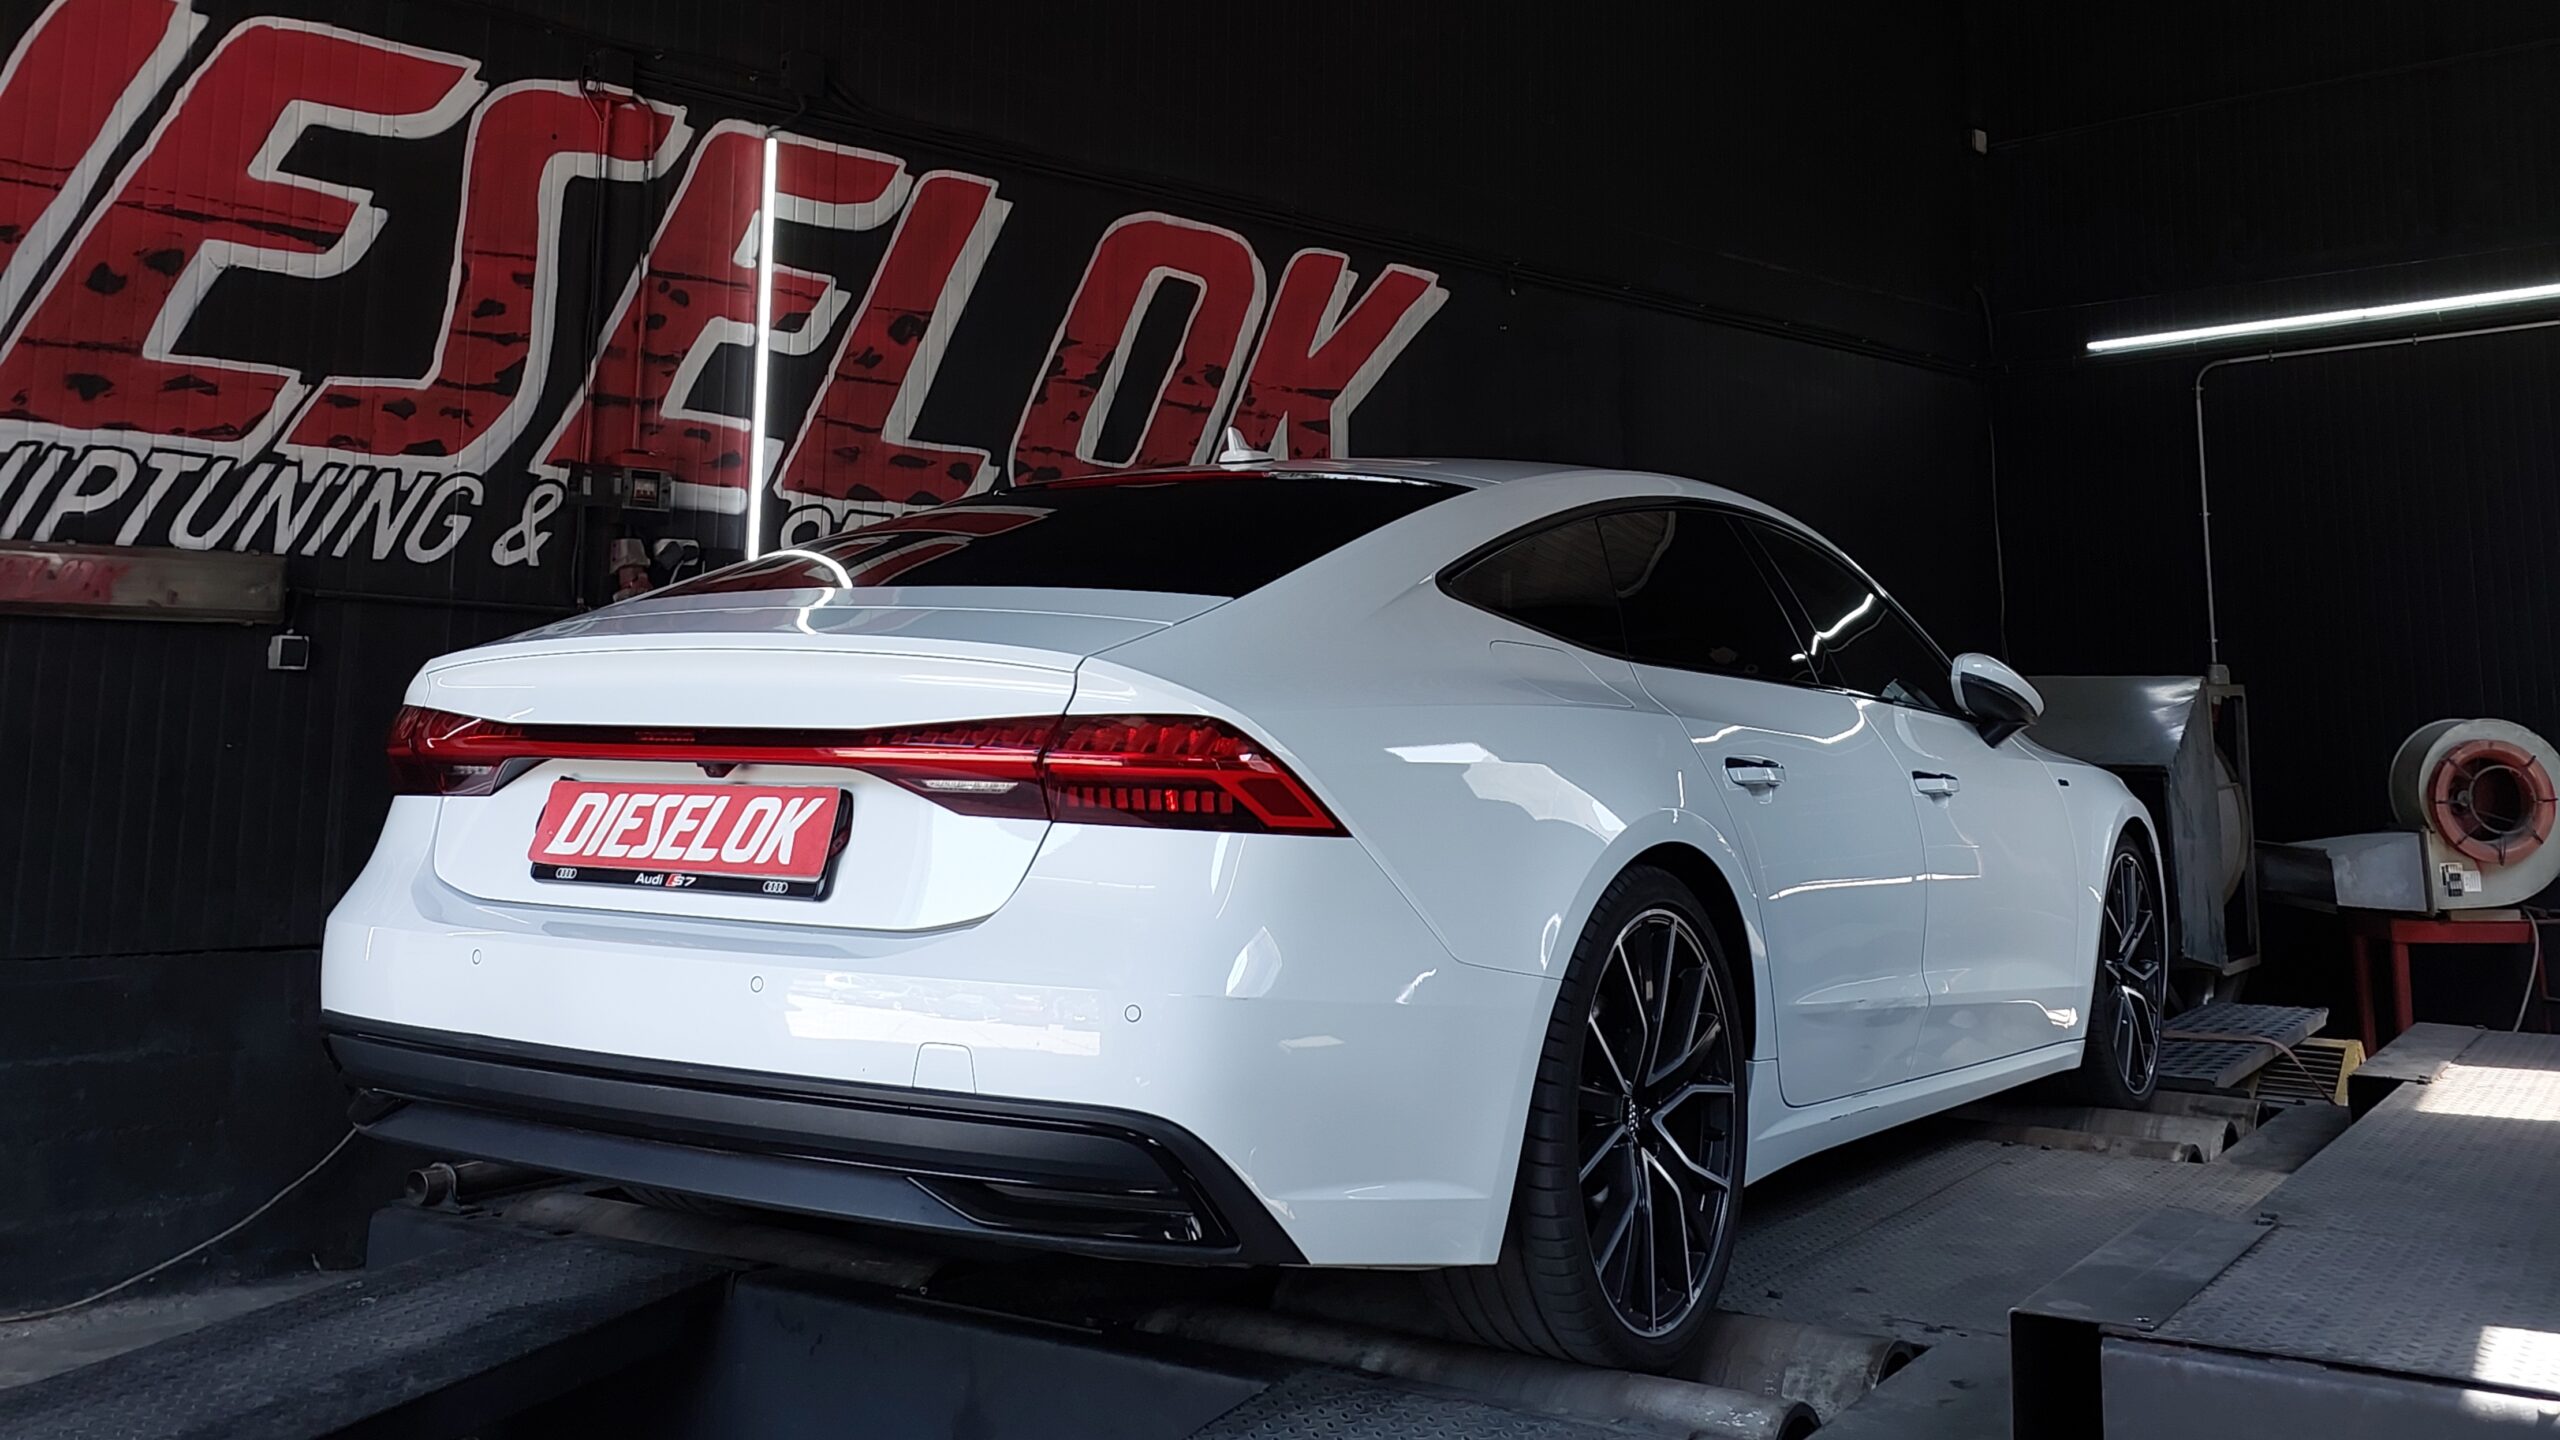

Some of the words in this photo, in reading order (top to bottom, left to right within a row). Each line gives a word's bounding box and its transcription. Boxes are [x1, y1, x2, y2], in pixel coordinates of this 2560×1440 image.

[491, 481, 568, 567] &
[543, 791, 827, 865] DIESELOK
[634, 872, 664, 886] Audi
[666, 873, 697, 887] S7
